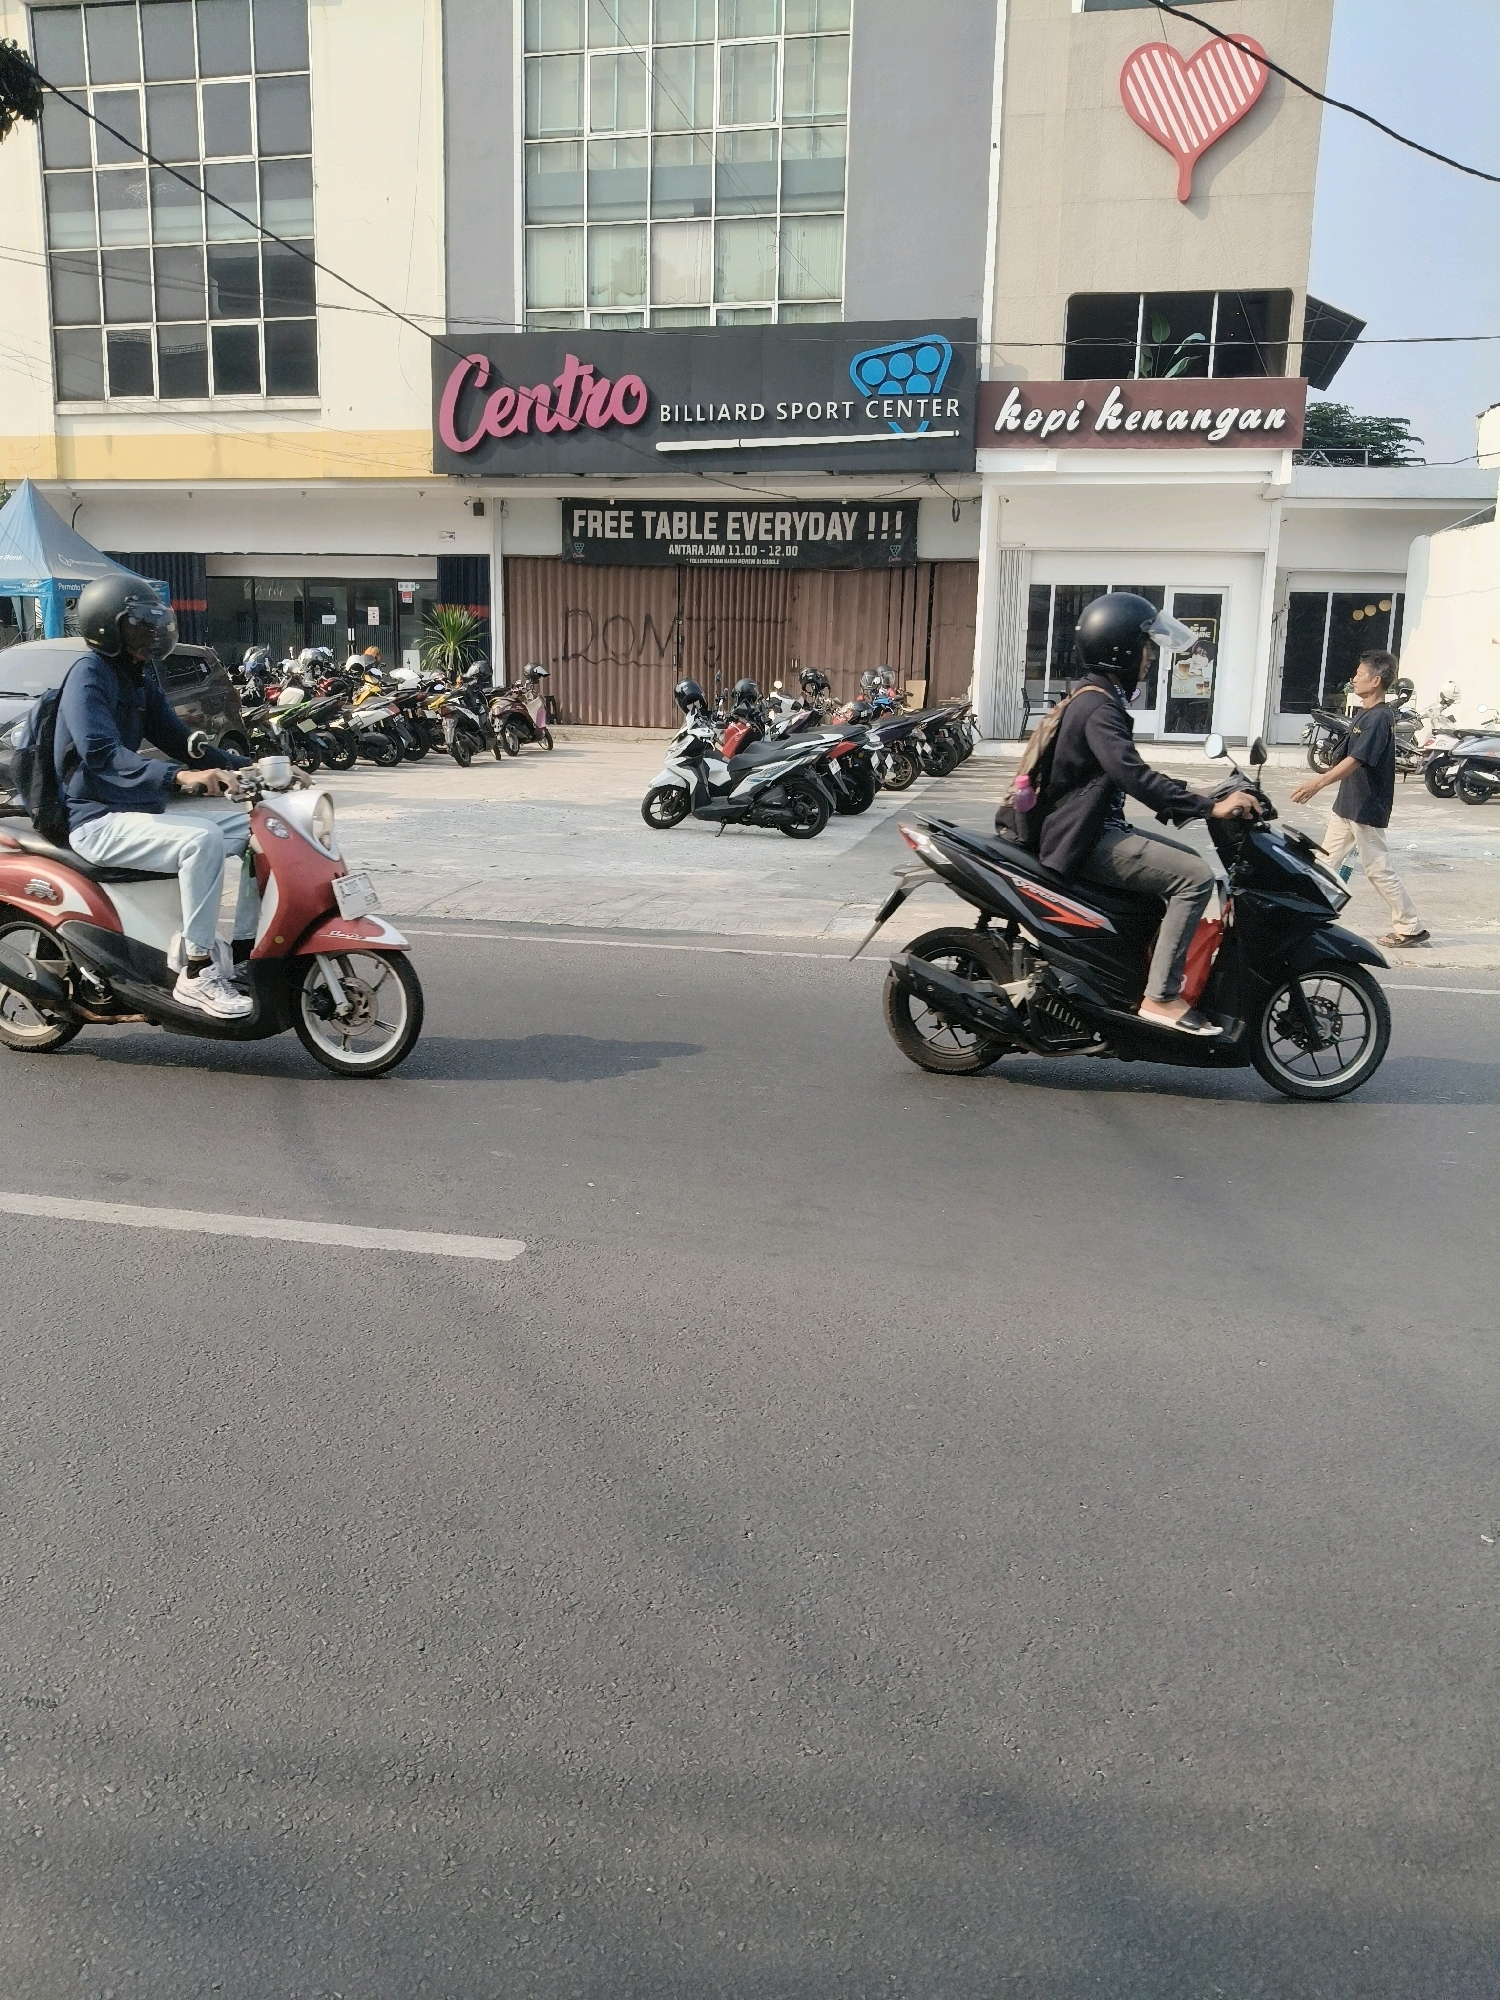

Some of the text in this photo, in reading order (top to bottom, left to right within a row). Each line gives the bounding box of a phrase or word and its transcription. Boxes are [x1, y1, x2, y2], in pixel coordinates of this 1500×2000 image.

[439, 353, 648, 453] Centro
[660, 398, 960, 422] BILLIARD SPORT CENTER
[994, 385, 1286, 441] kopi kenangan
[572, 509, 634, 539] FREE
[641, 510, 719, 540] TABLE
[726, 511, 859, 541] EVERYDAY
[668, 544, 704, 556] ANTARA
[705, 544, 725, 556] JAM
[728, 545, 757, 556] 11.00
[768, 545, 798, 556] 12.00
